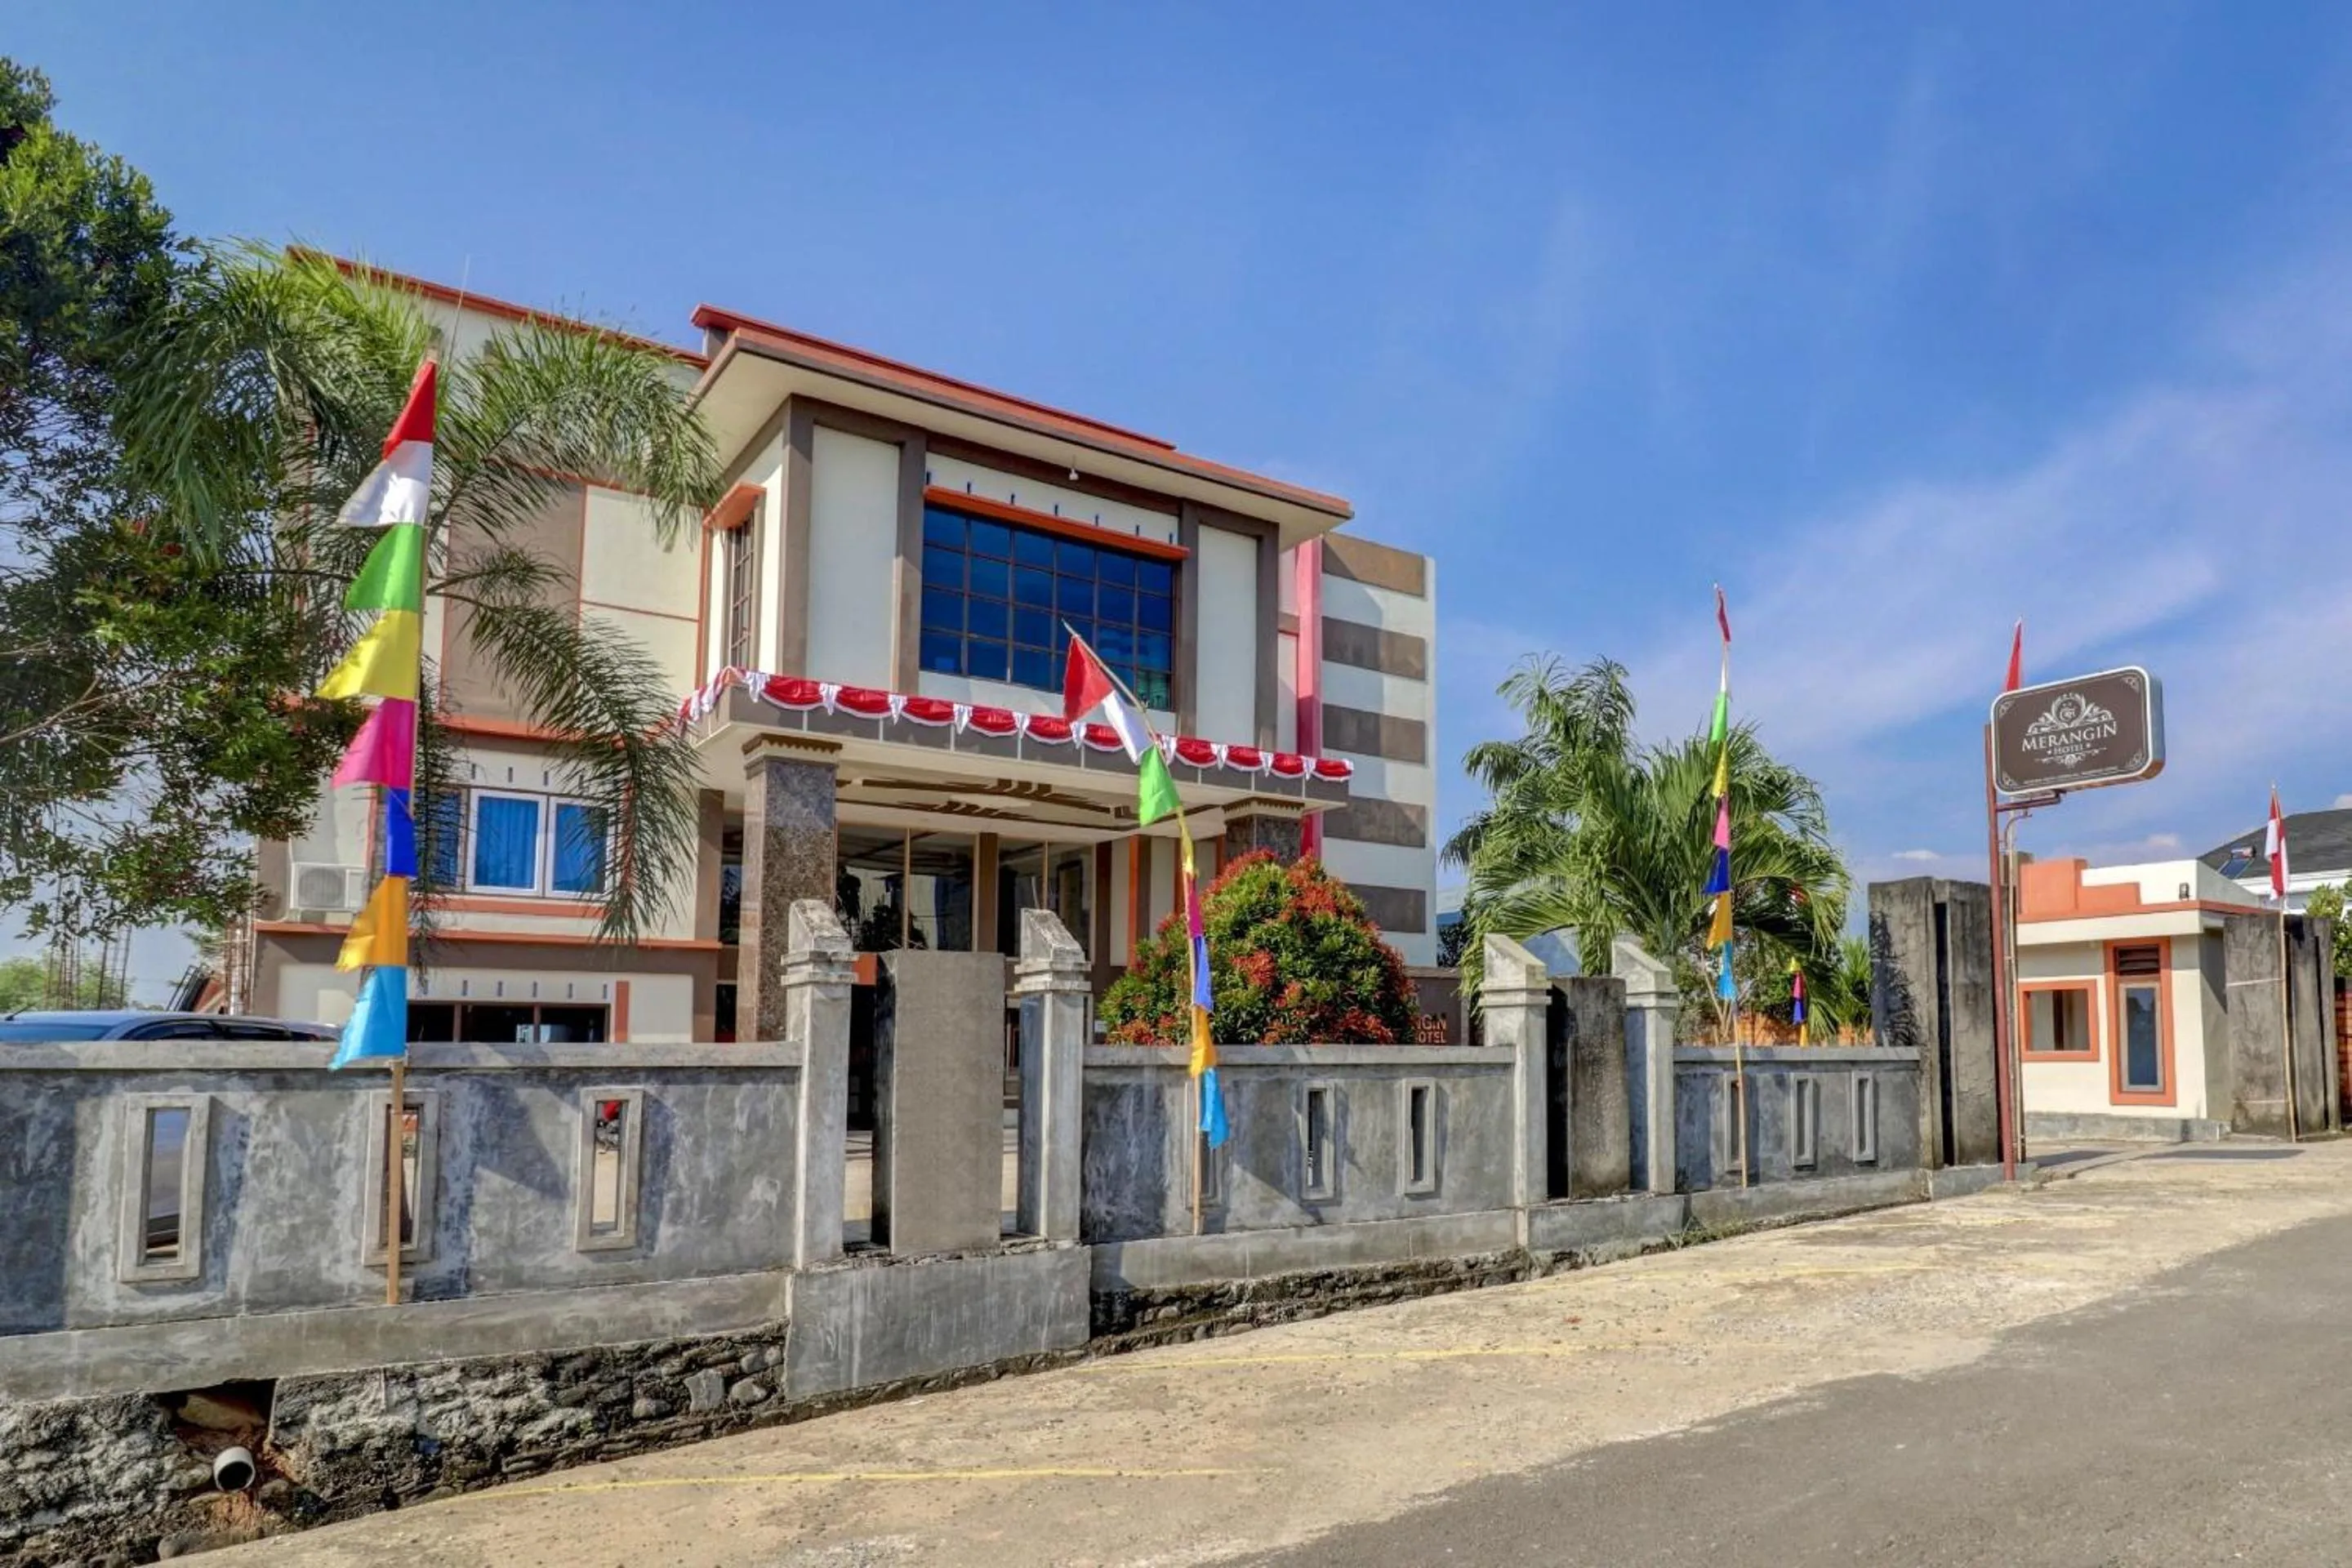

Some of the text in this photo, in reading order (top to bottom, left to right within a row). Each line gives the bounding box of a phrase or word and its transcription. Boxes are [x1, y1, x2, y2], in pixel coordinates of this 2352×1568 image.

[2022, 721, 2117, 752] MERANGIN
[2053, 744, 2083, 755] HOTEL
[1415, 1031, 1446, 1044] OTEL
